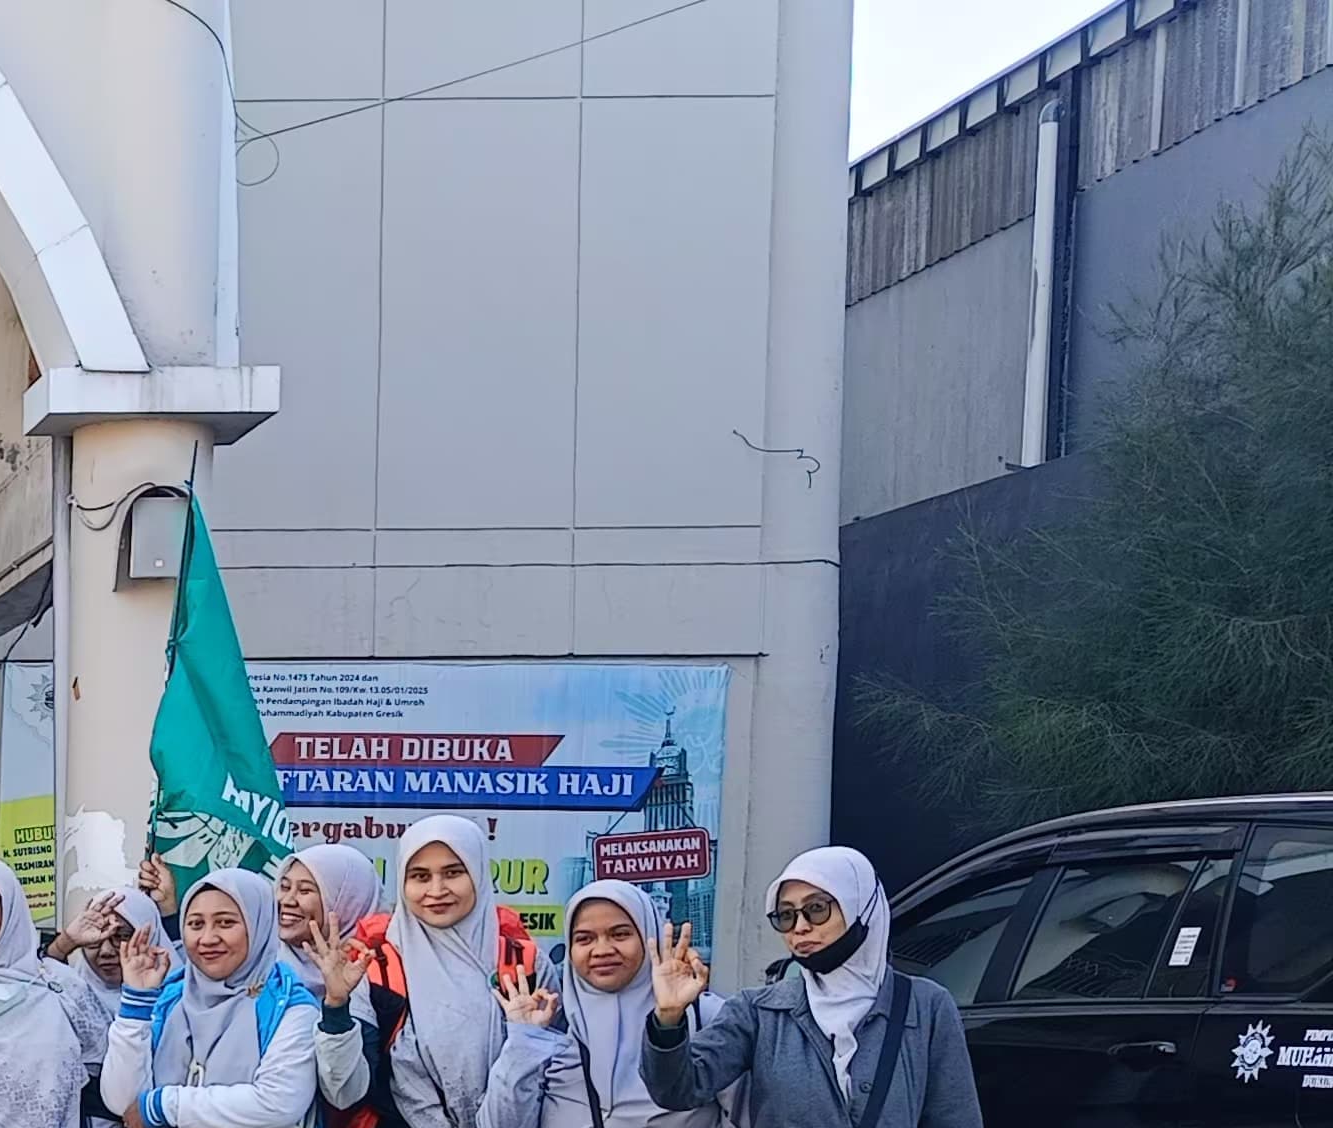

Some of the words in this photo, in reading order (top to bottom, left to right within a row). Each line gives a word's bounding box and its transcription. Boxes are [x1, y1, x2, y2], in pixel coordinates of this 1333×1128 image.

[247, 673, 271, 681] nesia
[310, 673, 338, 682] Tahun
[339, 674, 360, 682] 2024
[361, 674, 379, 682] dan
[263, 685, 292, 693] Kanwil
[294, 686, 318, 694] Jatim
[266, 697, 332, 707] Pendampingan
[333, 697, 364, 706] Ibadah
[366, 698, 383, 708] Haji
[385, 698, 392, 706] &
[258, 709, 324, 718] uhammadiyah
[326, 709, 374, 719] Kabupaten
[375, 710, 404, 718] Gresik
[295, 736, 390, 761] TELAH
[401, 737, 514, 762] DIBUKA
[275, 769, 395, 794] FTARAN
[404, 770, 549, 795] MANASIK
[557, 773, 633, 796] HAJI
[15, 825, 55, 843] HUBU
[13, 845, 52, 857] SUTRISNO
[599, 837, 700, 857] MELAKSANAKAN
[602, 854, 699, 874] TARWIYAH
[520, 912, 556, 930] ESIK
